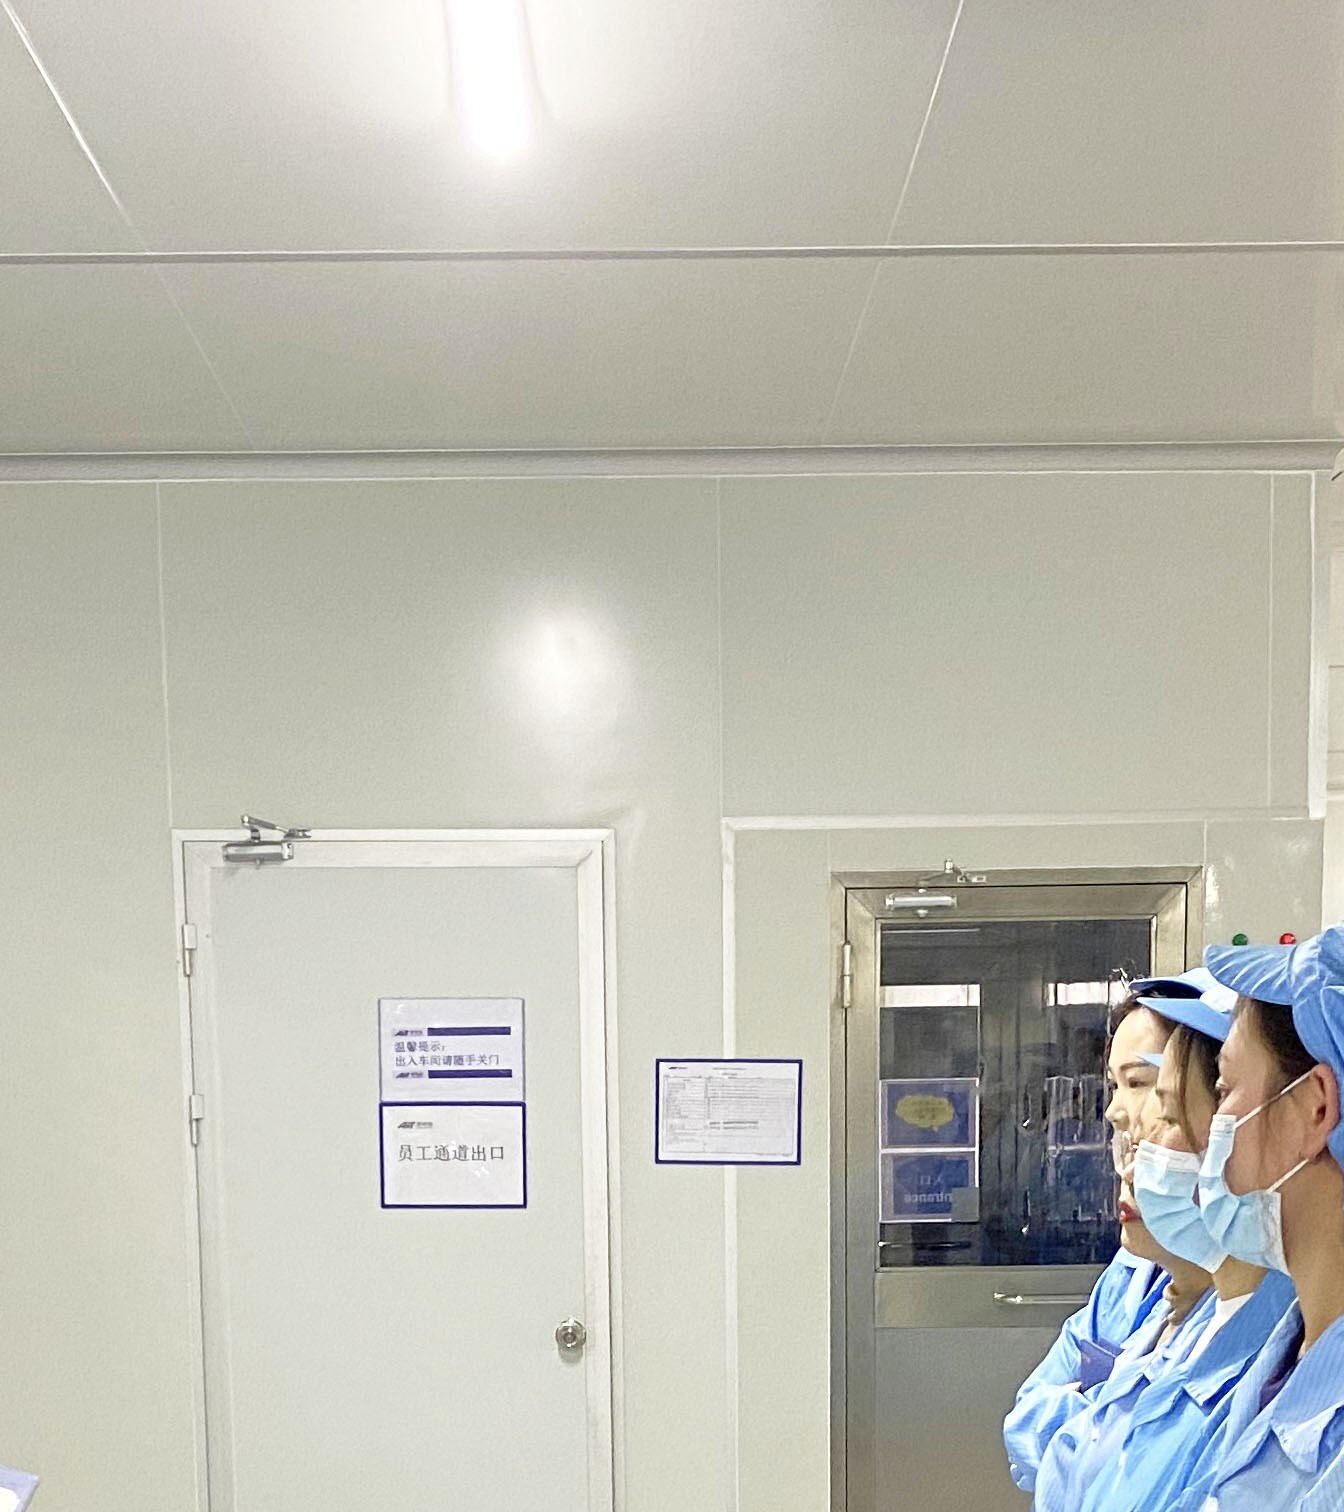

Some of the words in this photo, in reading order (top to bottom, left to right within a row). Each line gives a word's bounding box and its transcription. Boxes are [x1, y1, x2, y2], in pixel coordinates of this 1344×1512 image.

[395, 1054, 500, 1067] 出入车间请随手关门
[398, 1144, 504, 1162] 员工通道出口
